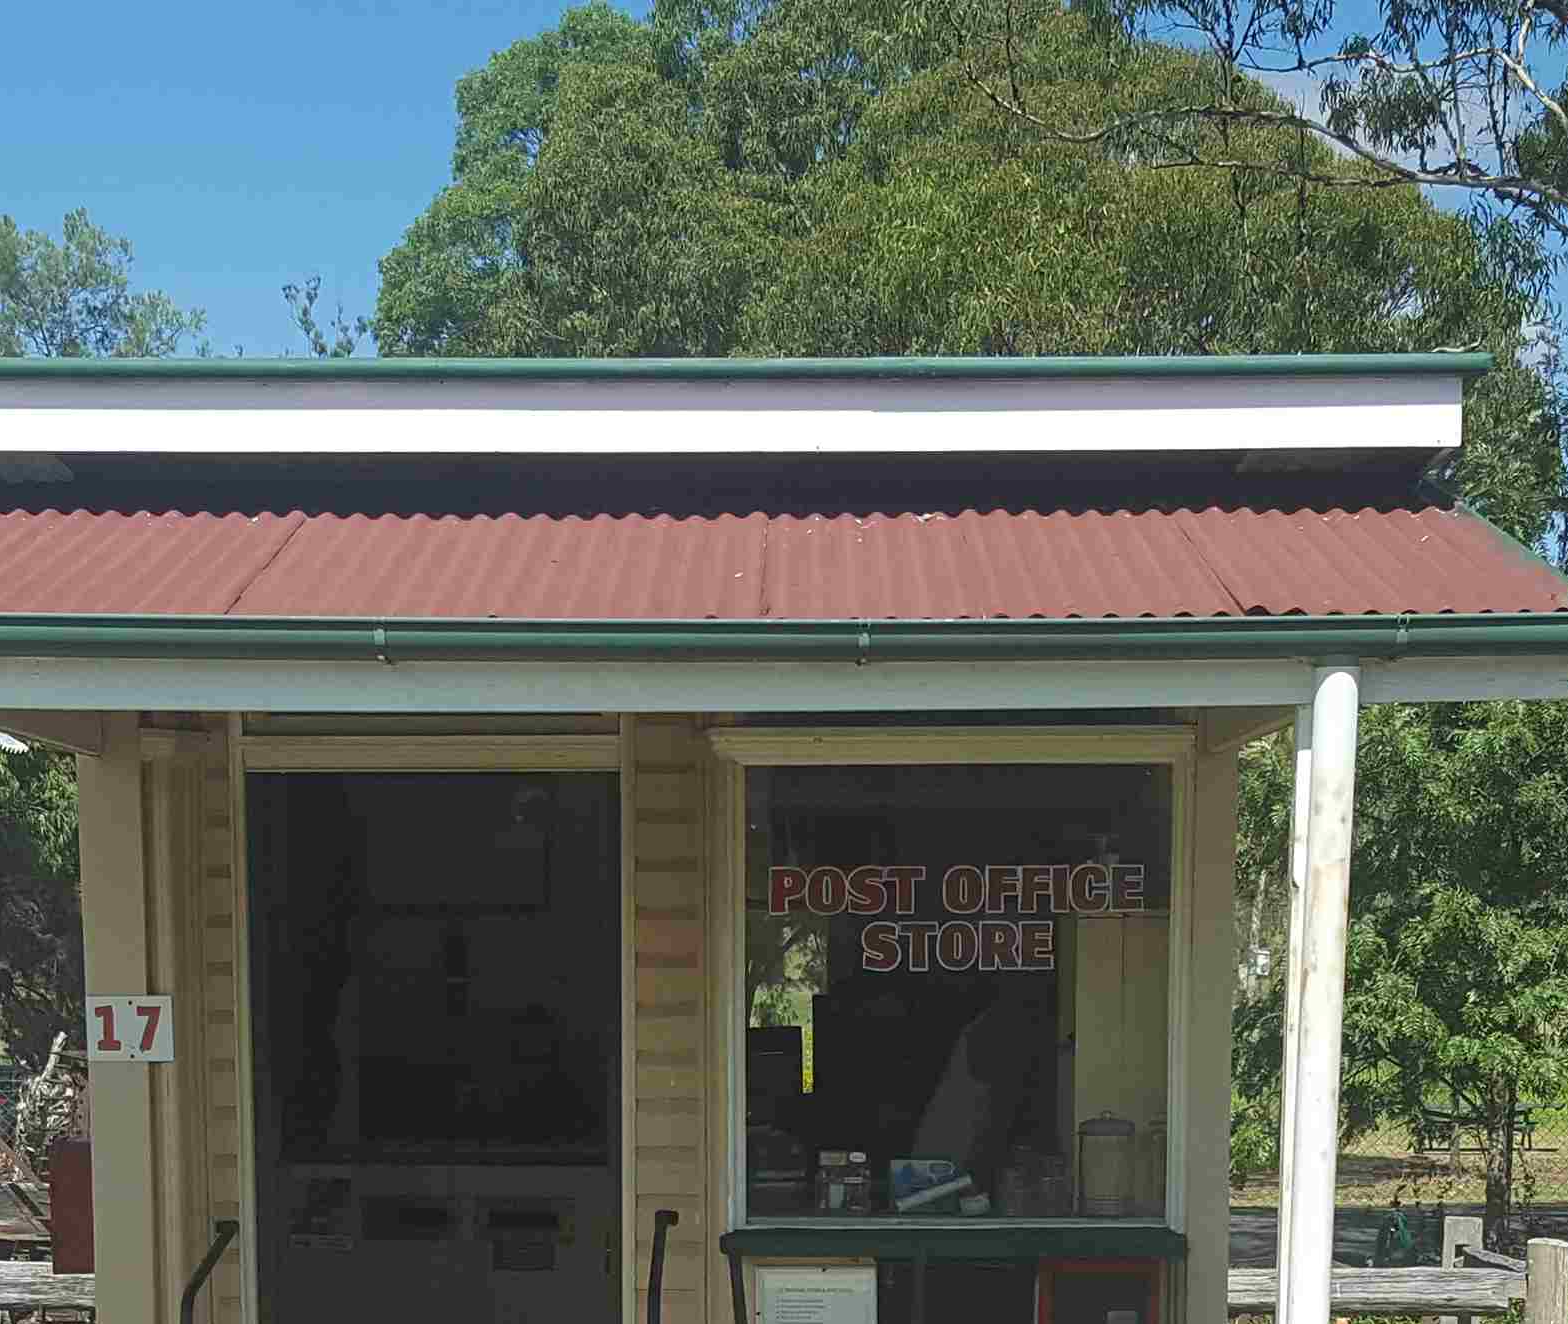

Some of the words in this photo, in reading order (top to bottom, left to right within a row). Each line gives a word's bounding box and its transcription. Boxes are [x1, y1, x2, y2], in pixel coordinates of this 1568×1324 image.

[768, 865, 926, 915] POST
[942, 863, 1145, 914] OFFICE
[861, 920, 1056, 971] STORE
[93, 1005, 161, 1053] 17
